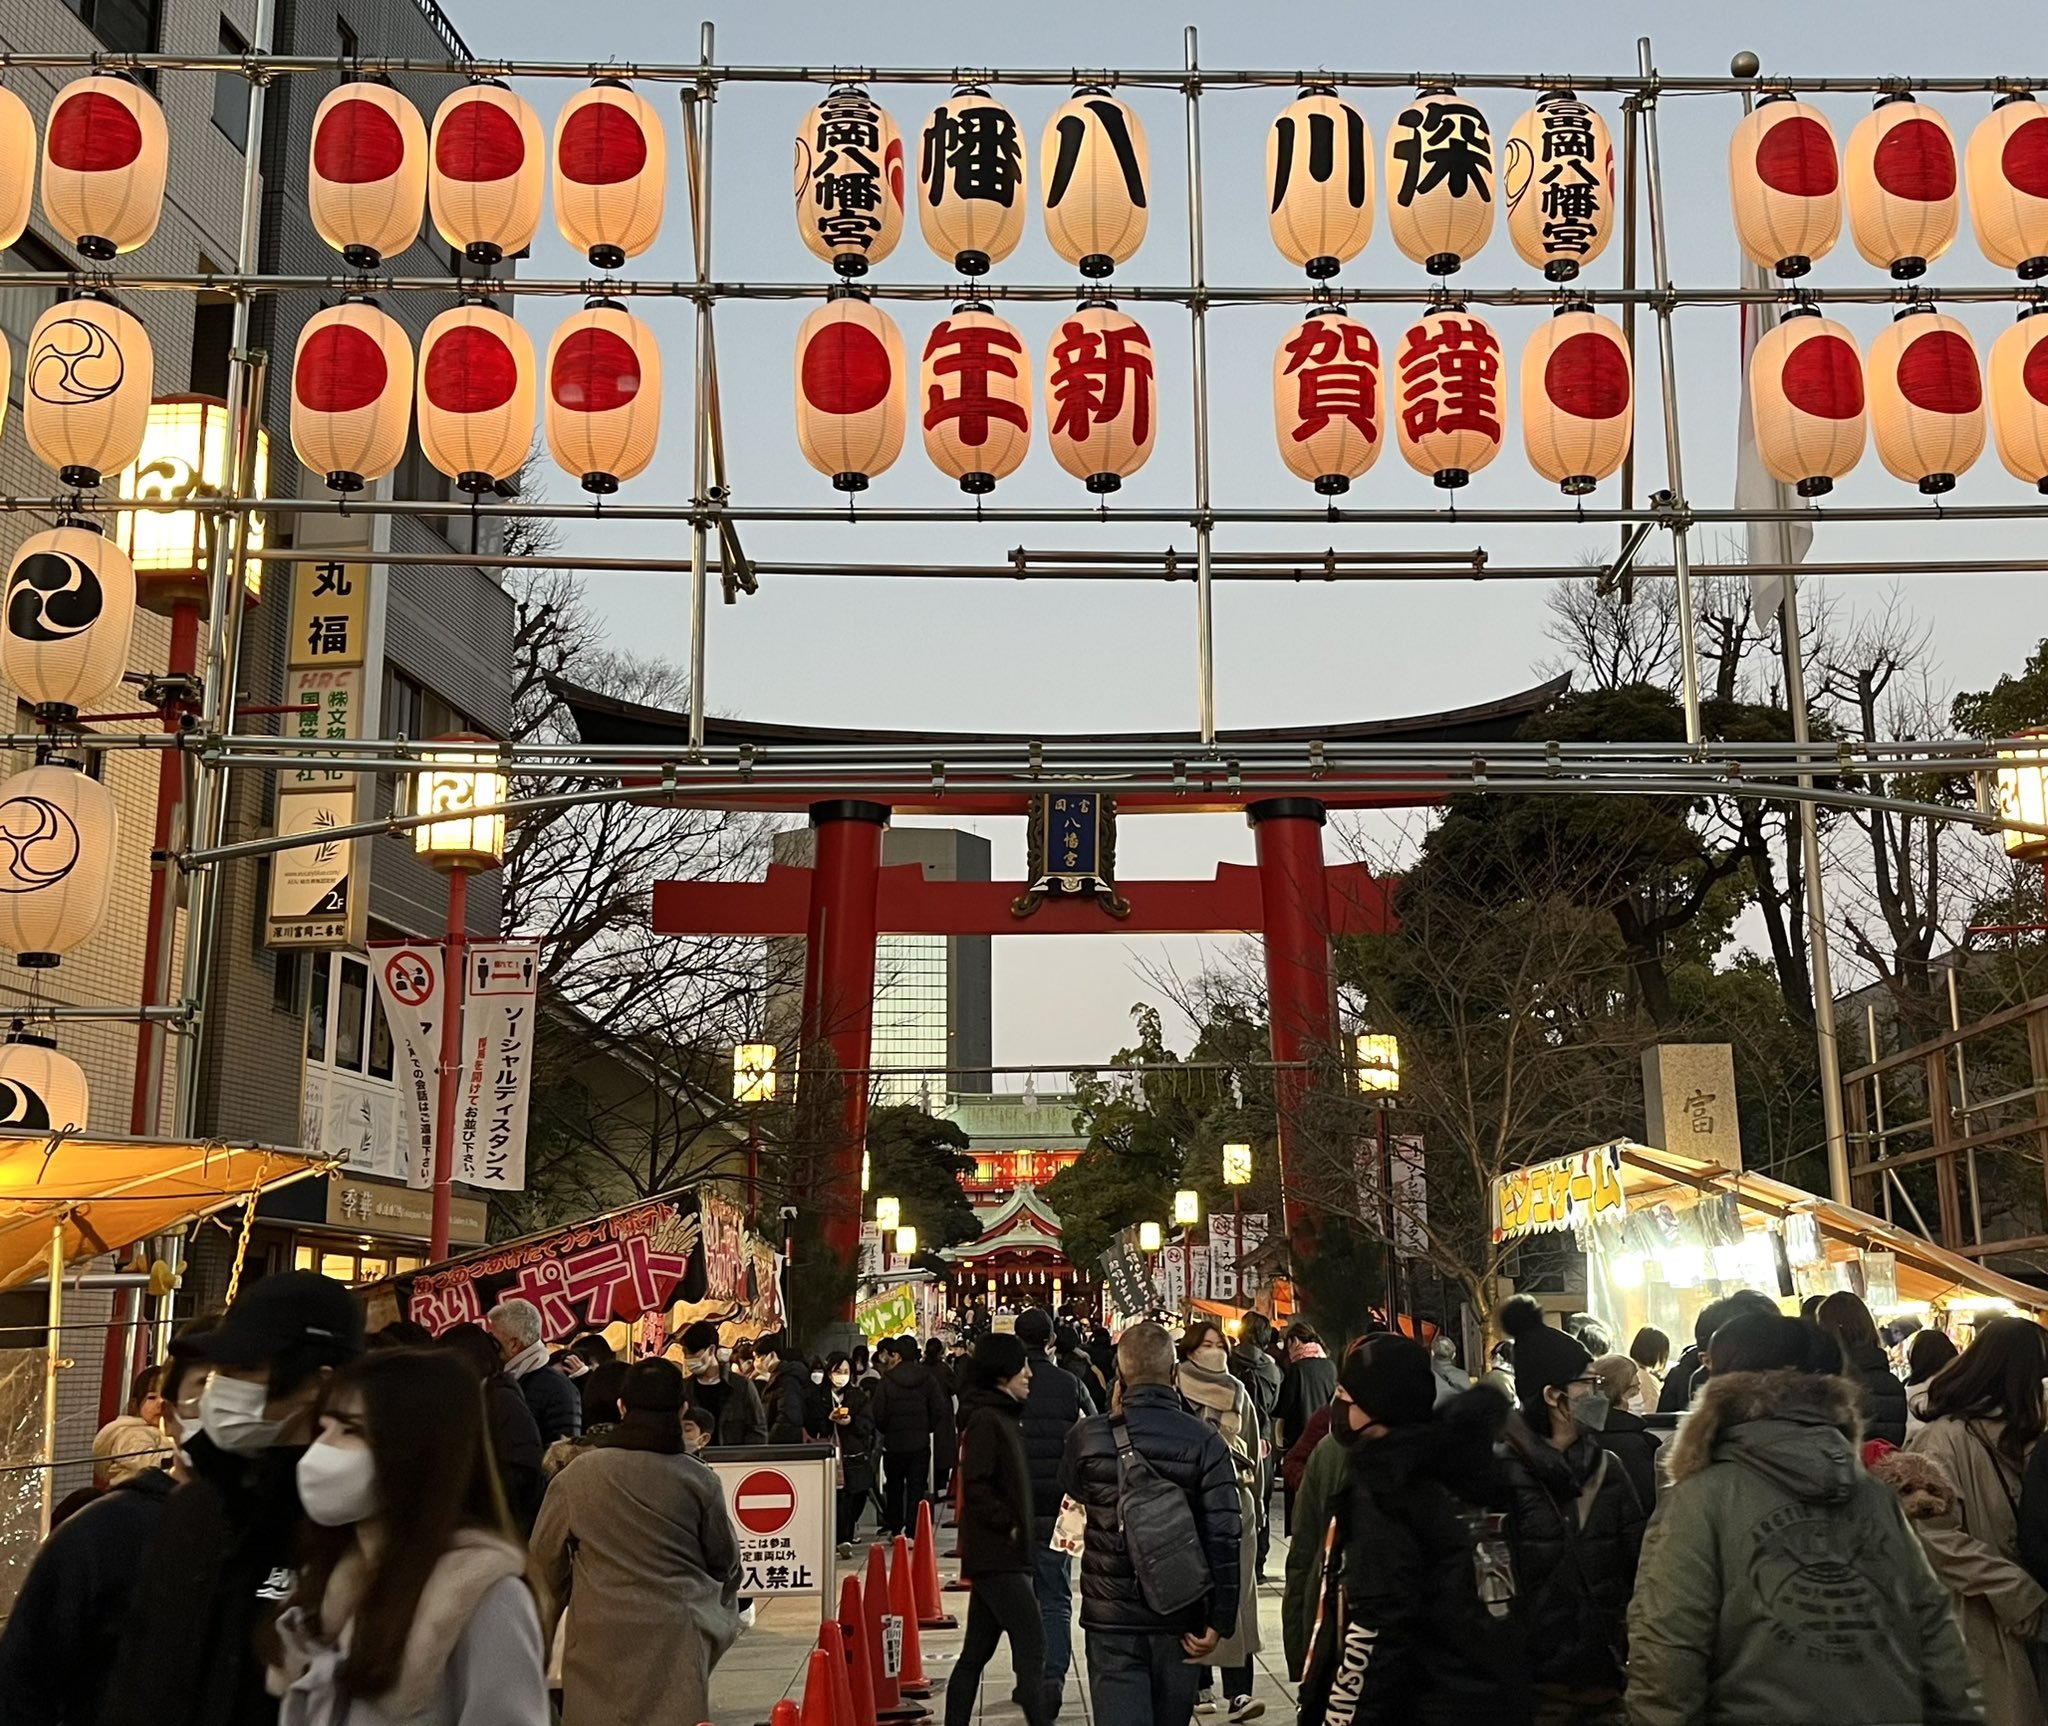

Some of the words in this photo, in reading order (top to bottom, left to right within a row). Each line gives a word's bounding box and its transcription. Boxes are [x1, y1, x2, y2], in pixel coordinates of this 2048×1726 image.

[308, 561, 352, 655] 丸福
[298, 672, 353, 689] HRC
[326, 891, 345, 910] 2F
[484, 1007, 524, 1181] ソーシャルディスタンス
[1498, 1150, 1622, 1231] ビンゴゲーム
[740, 1549, 797, 1563] 定車両以外
[738, 1564, 814, 1590] 入禁止
